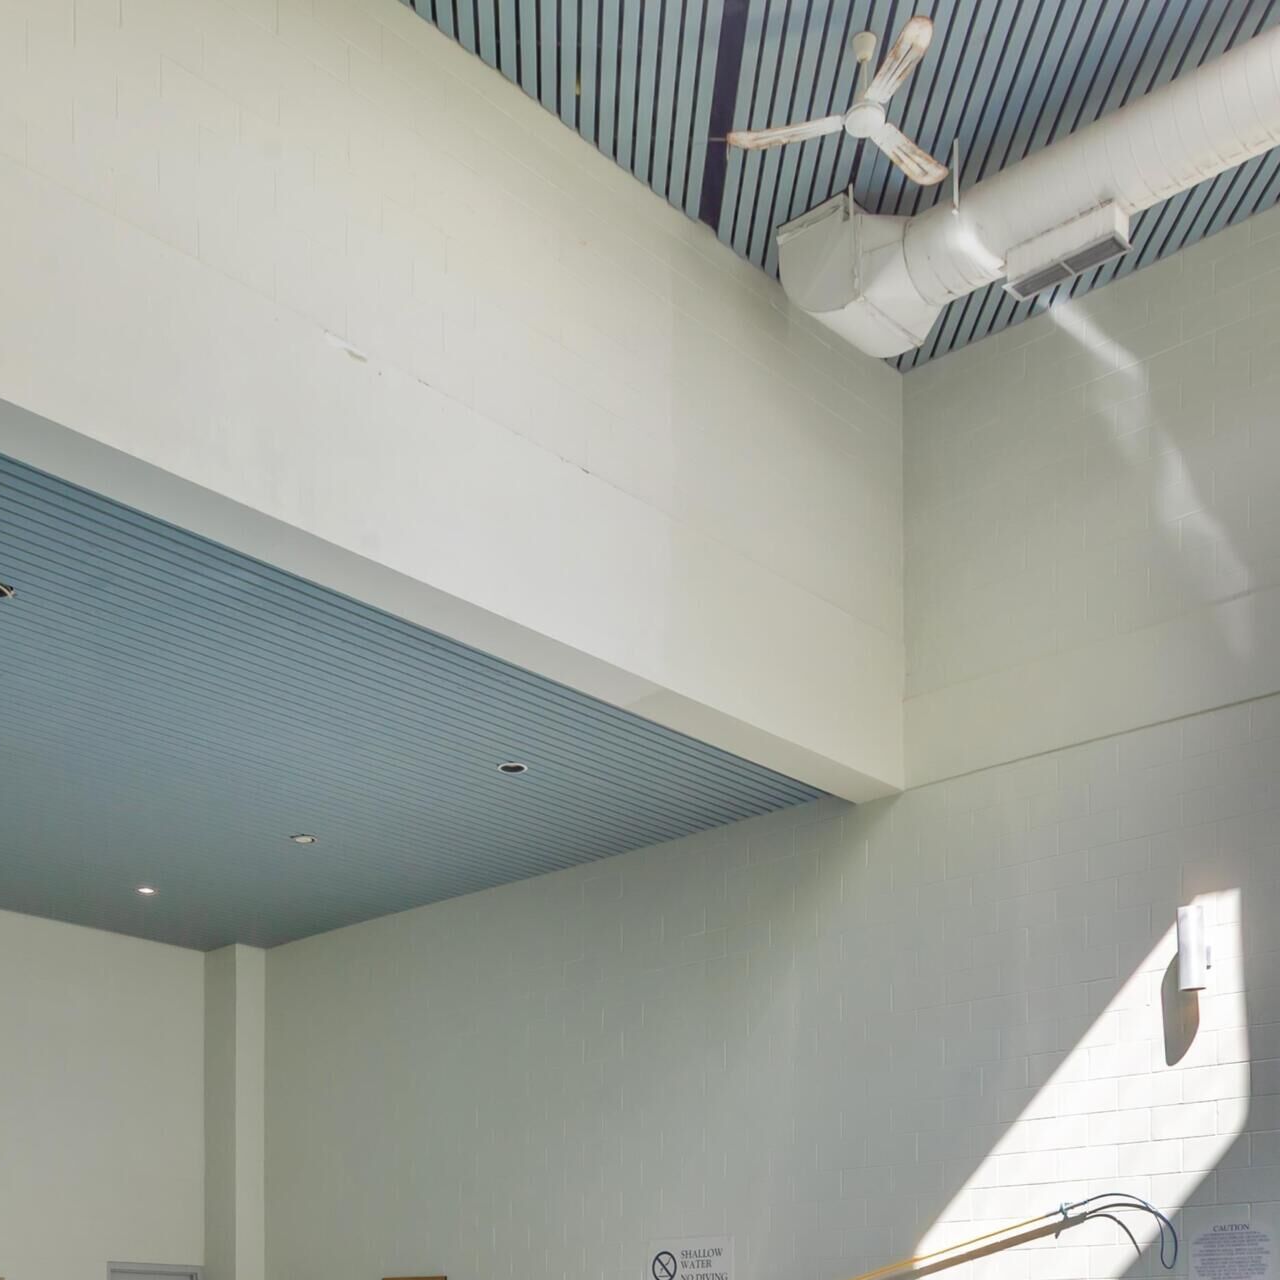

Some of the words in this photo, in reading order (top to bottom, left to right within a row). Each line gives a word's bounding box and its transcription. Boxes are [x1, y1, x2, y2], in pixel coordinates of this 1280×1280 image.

[1212, 1223, 1250, 1232] CAUTION
[680, 1248, 723, 1259] SHALLOW
[680, 1259, 712, 1269] WATER
